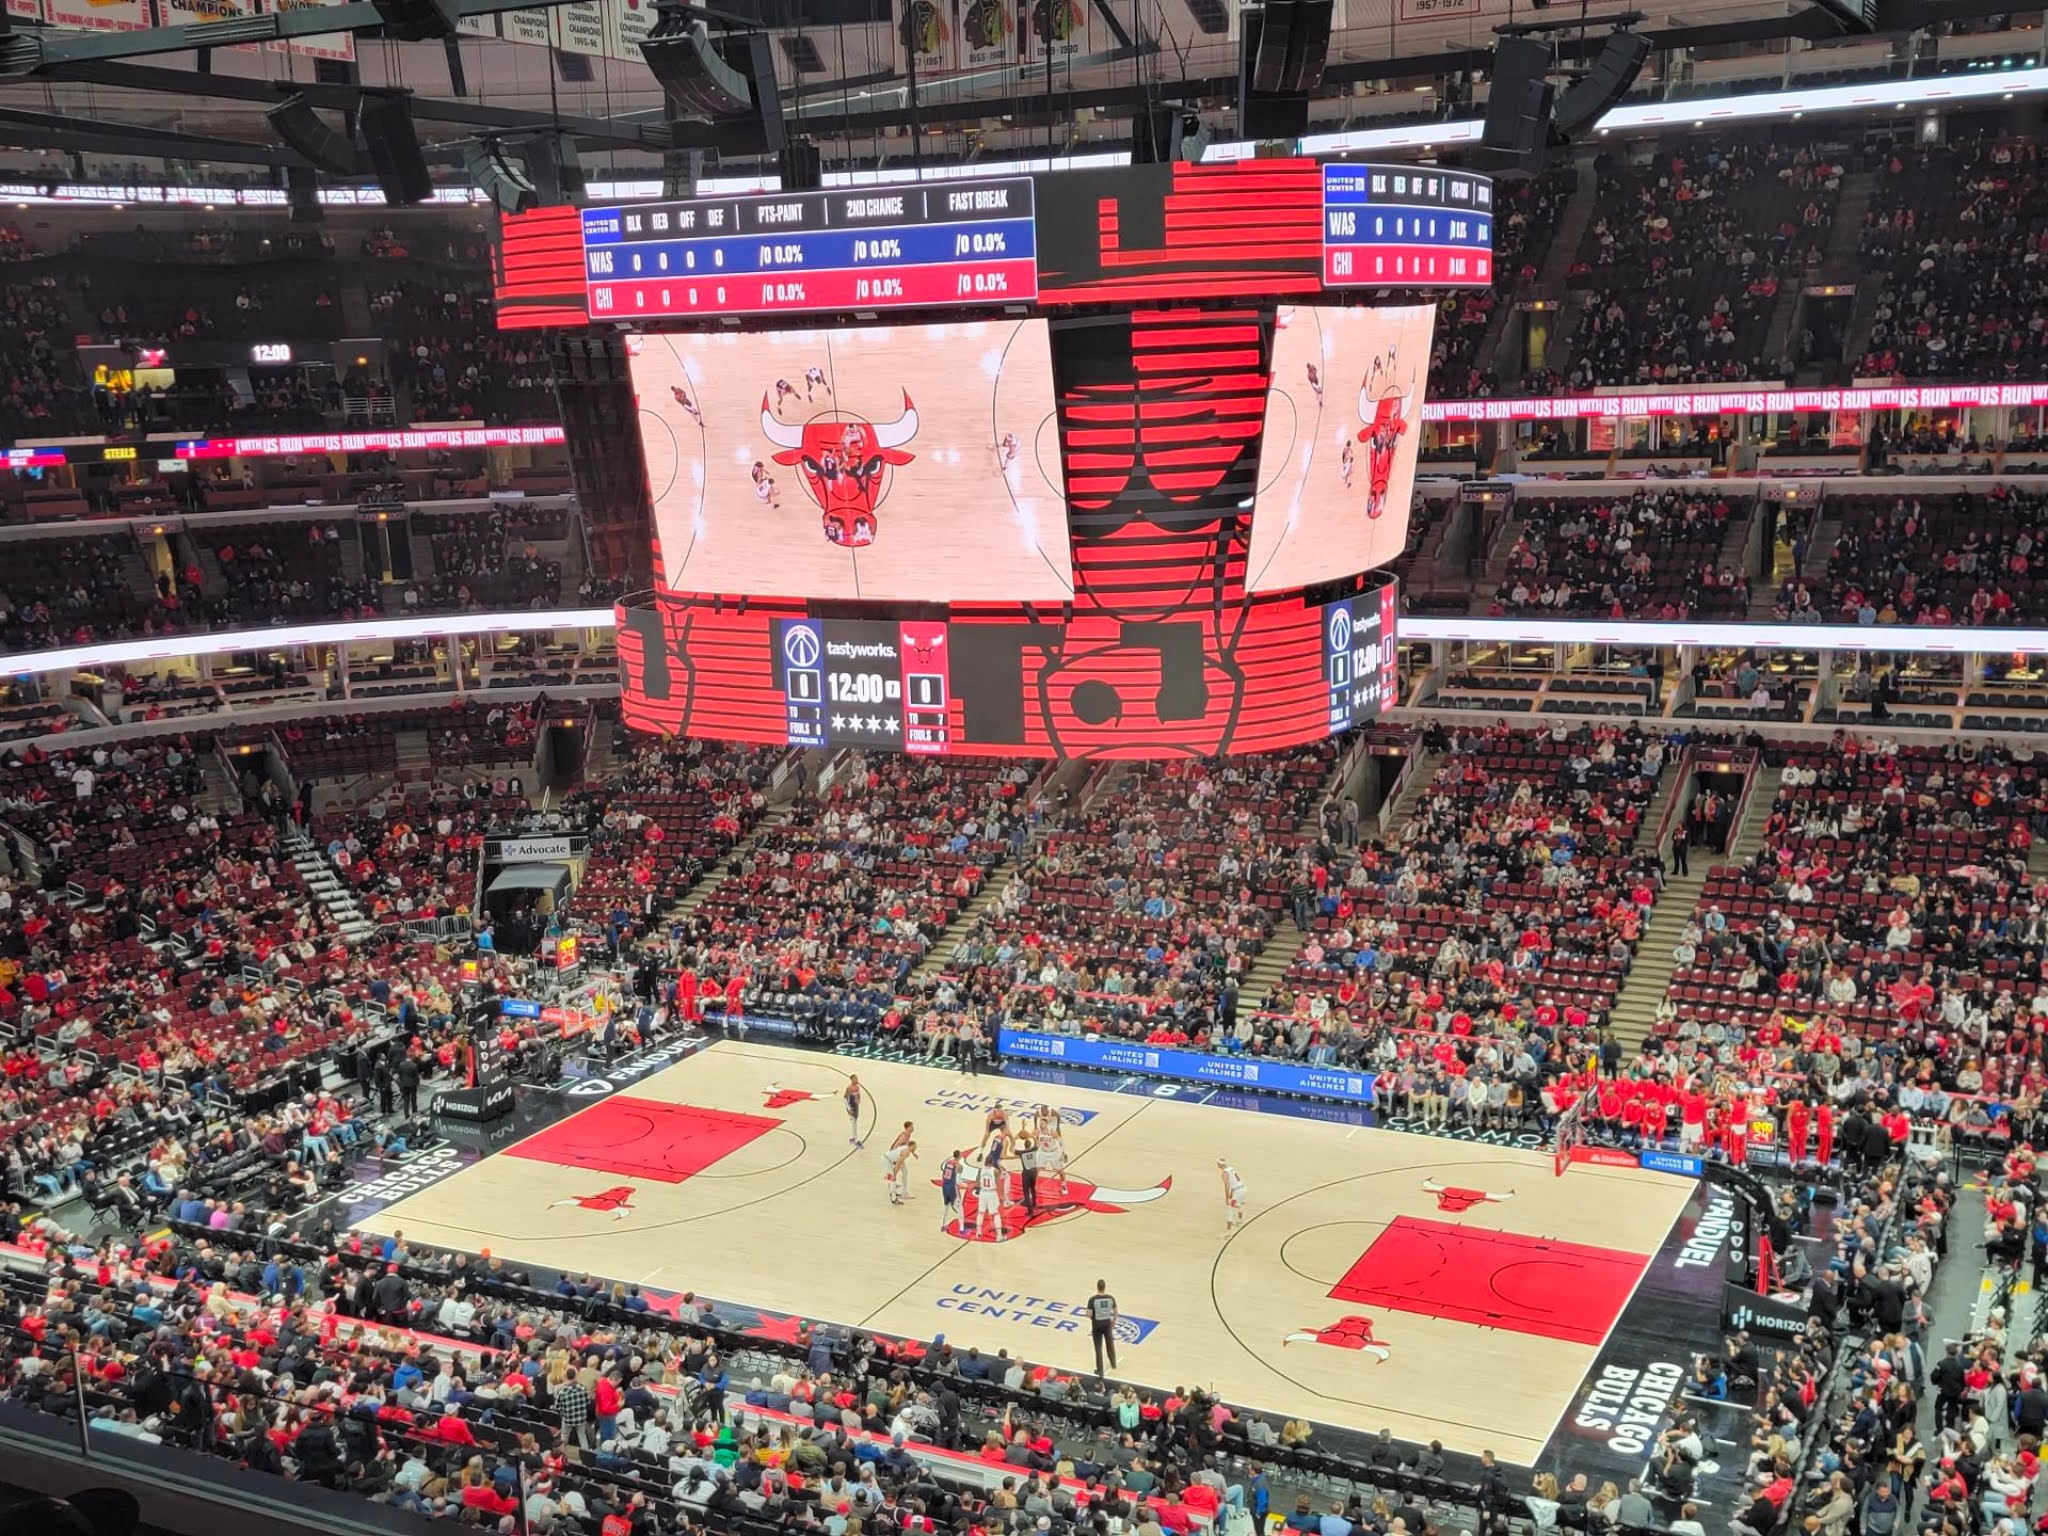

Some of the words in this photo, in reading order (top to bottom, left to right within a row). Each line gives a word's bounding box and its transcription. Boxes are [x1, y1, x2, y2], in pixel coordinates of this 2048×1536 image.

[171, 0, 243, 17] CHAMPIONS
[1372, 175, 1386, 193] BLK
[846, 200, 865, 218] 2ND
[866, 196, 904, 217] CHANCE
[950, 192, 974, 211] FAST
[976, 189, 1008, 210] BREAK
[626, 214, 642, 232] BLK
[652, 212, 669, 230] REB
[680, 210, 695, 228] OFF
[708, 208, 724, 226] DEF
[758, 203, 803, 224] PTS-PAINT
[584, 219, 609, 227] UNITED
[1329, 212, 1356, 236] WAS
[1375, 217, 1383, 236] 0
[589, 251, 613, 273] WAS
[633, 254, 641, 272] 0
[659, 252, 668, 270] 0
[686, 250, 695, 268] 0
[715, 248, 724, 266] 0
[760, 246, 771, 267] /0
[774, 244, 803, 264] 0.0%
[854, 240, 867, 262] /0
[870, 239, 901, 259] 0.0%
[956, 234, 969, 256] /0
[973, 232, 1006, 253] 0.0%
[1333, 252, 1353, 275] CHI
[1375, 256, 1383, 275] 0
[595, 287, 613, 309] CHI
[636, 291, 644, 307] 0
[662, 289, 670, 306] 0
[689, 288, 698, 305] 0
[717, 286, 726, 304] 0
[762, 283, 774, 305] /0
[777, 283, 806, 301] 0.0%
[856, 279, 869, 300] /0
[872, 278, 903, 297] 0.0%
[957, 274, 971, 295] /0
[975, 273, 1007, 291] 0.0%
[252, 344, 291, 361] 12:00
[1422, 403, 1445, 420] RUN
[1445, 402, 1468, 416] WITH
[1468, 402, 1485, 419] US
[1486, 401, 1510, 418] RUN
[1510, 401, 1535, 414] WITH
[1535, 400, 1551, 417] US
[1553, 399, 1578, 416] RUN
[1578, 398, 1603, 413] WITH
[1603, 398, 1620, 415] US
[1622, 397, 1648, 414] RUN
[1648, 396, 1673, 410] WITH
[1674, 396, 1691, 413] US
[1693, 395, 1720, 412] RUN
[1720, 394, 1747, 408] WITH
[1747, 393, 1764, 410] US
[1766, 393, 1794, 410] RUN
[1794, 392, 1822, 406] WITH
[1822, 391, 1840, 409] US
[1842, 390, 1871, 408] RUN
[1870, 389, 1899, 404] WITH
[1899, 388, 1918, 406] US
[1920, 388, 1950, 406] RUN
[1950, 387, 1979, 402] WITH
[1980, 386, 1999, 405] US
[2002, 385, 2032, 404] RUN
[241, 438, 263, 452] WITH
[264, 437, 279, 453] US
[279, 436, 303, 452] RUN
[302, 435, 325, 448] WITH
[325, 435, 340, 451] US
[342, 434, 365, 450] RUN
[365, 433, 387, 446] WITH
[388, 432, 402, 447] US
[403, 431, 426, 447] RUN
[426, 430, 448, 444] WITH
[447, 430, 463, 445] US
[463, 429, 486, 445] RUN
[486, 429, 507, 442] WITH
[507, 428, 521, 443] US
[522, 427, 544, 442] RUN
[544, 427, 565, 439] WITH
[104, 447, 137, 460] STEALS
[826, 641, 897, 659] tastyworks.
[1352, 643, 1377, 679] 12:00
[799, 673, 809, 698] 0
[828, 672, 883, 703] 12:00
[920, 679, 931, 703] 0
[789, 706, 798, 719] TO
[815, 708, 820, 719] 7
[908, 713, 919, 725] TO
[938, 713, 944, 726] 7
[789, 722, 810, 735] FOULS
[816, 724, 821, 736] 0
[909, 729, 931, 742] FOULS
[938, 730, 944, 742] 0
[519, 844, 566, 855] Advocate
[750, 992, 757, 1000] G
[763, 993, 770, 1002] G
[776, 994, 782, 1003] G
[1010, 1043, 1050, 1053] AIRLINES
[1018, 1037, 1050, 1046] UNITED
[606, 1036, 709, 1080] FANDUEL
[836, 1043, 957, 1064] CALAMO
[1102, 1054, 1143, 1065] AIRLINES
[1110, 1049, 1144, 1058] UNITED
[1199, 1066, 1242, 1078] AIRLINES
[1207, 1061, 1242, 1071] UNITED
[1300, 1079, 1346, 1091] AIRLINES
[1309, 1074, 1346, 1084] UNITED
[938, 1089, 1049, 1109] UNITED
[1153, 1084, 1182, 1096] 6
[446, 1102, 479, 1114] HORIZON
[1666, 1106, 1674, 1115] G
[1753, 1131, 1769, 1142] 24
[1655, 1156, 1682, 1164] UNITED
[338, 1148, 458, 1203] CHICAGO
[373, 1160, 463, 1201] BULLS
[1674, 1198, 1734, 1268] FANDUEL
[952, 1283, 1088, 1317] UNITED
[936, 1298, 1079, 1332] CENTER
[1756, 1315, 1808, 1333] HORIZO
[1575, 1364, 1640, 1431] BULLS
[1608, 1362, 1683, 1454] CHICAGO
